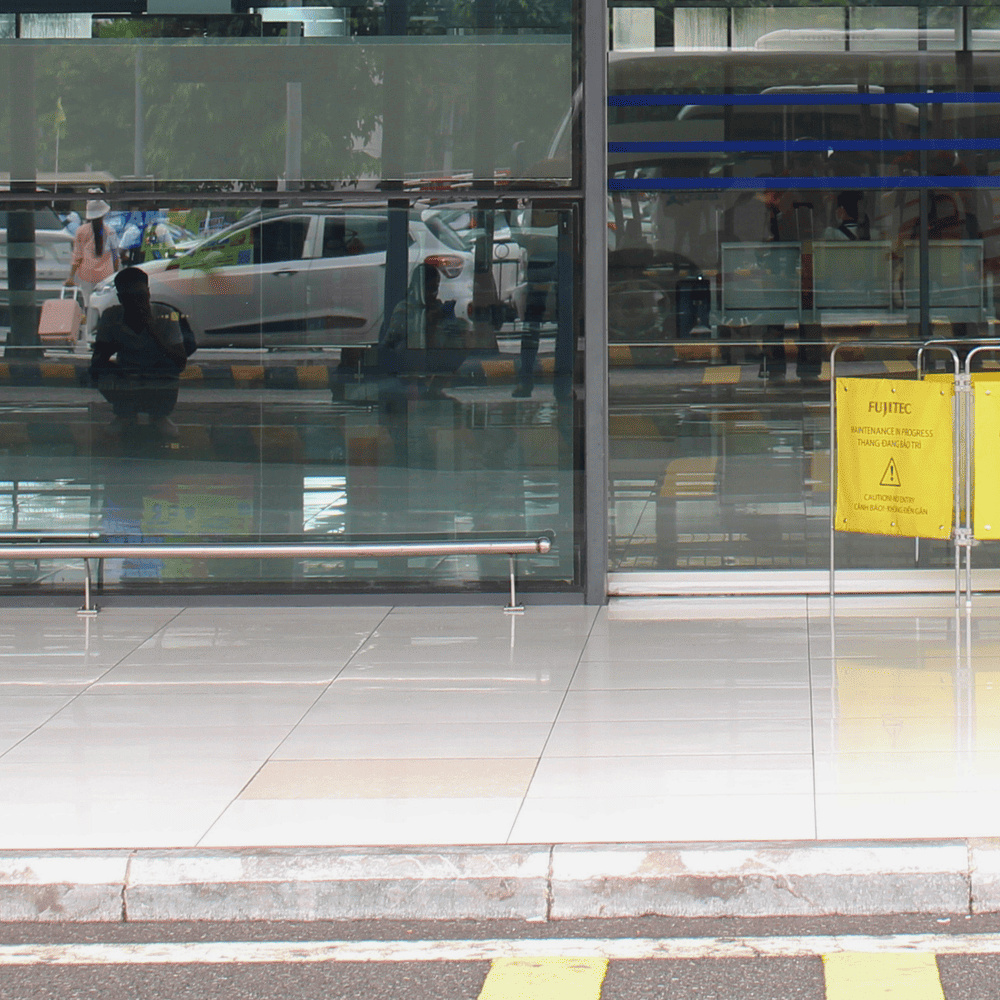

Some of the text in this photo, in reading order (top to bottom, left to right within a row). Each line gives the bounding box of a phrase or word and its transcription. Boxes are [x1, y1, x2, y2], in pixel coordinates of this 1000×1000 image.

[868, 401, 912, 417] FUJITEC
[850, 426, 895, 436] MAINTENANCE
[901, 428, 934, 438] PROGRESS
[857, 438, 880, 448] THANG
